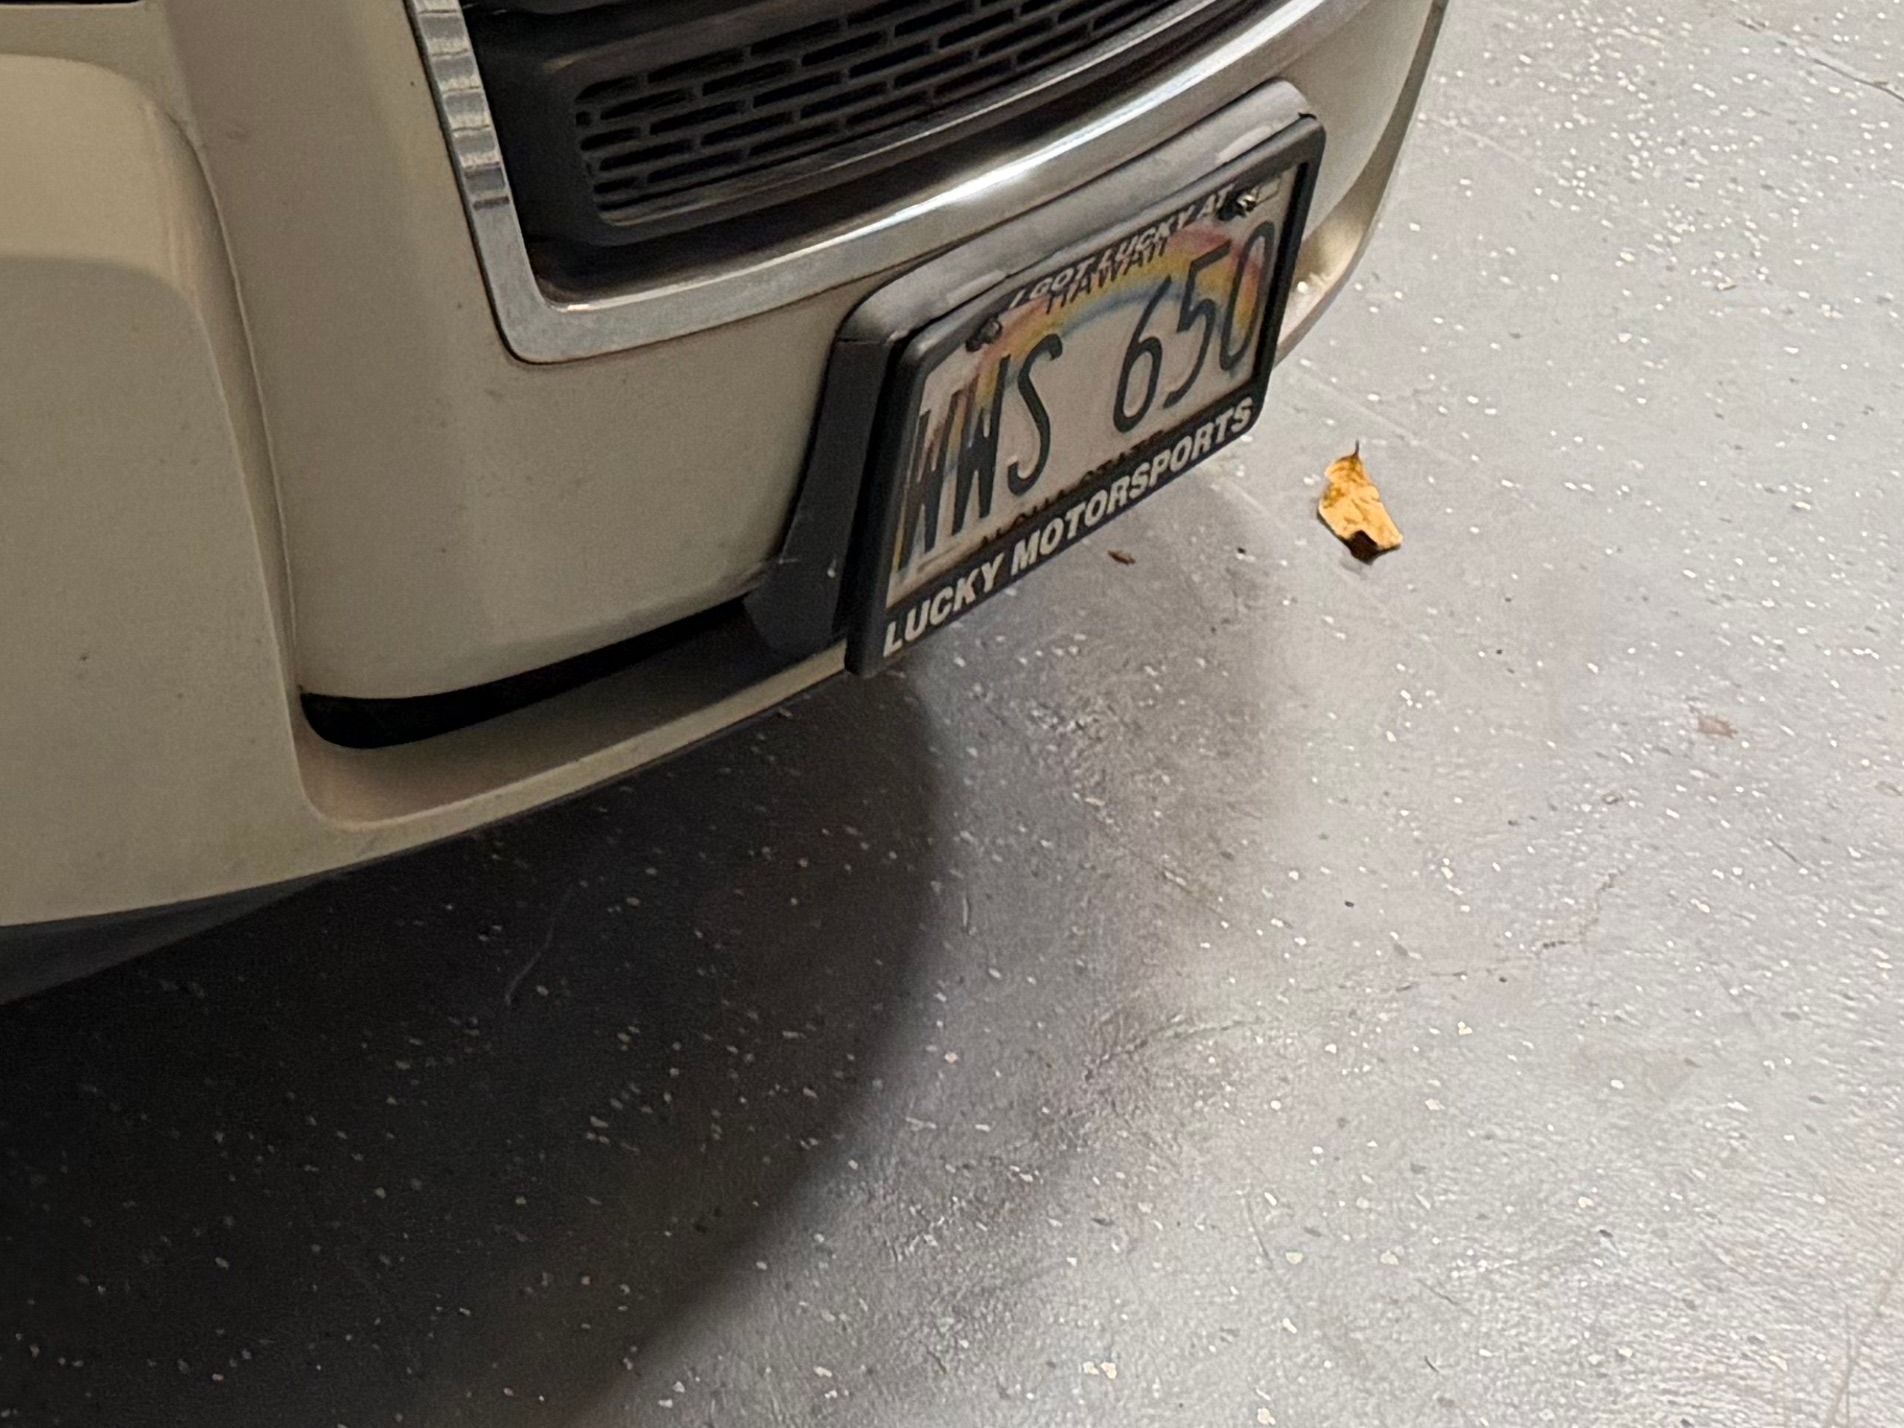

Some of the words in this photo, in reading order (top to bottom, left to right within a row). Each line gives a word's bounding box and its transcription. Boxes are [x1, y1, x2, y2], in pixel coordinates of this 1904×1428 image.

[1029, 257, 1096, 300] GOT
[1096, 204, 1196, 270] LUCKY
[1198, 183, 1234, 219] AT
[1112, 219, 1276, 434] 650
[882, 552, 1005, 659] LUCKY
[1010, 396, 1257, 577] MOTORSPORTS
